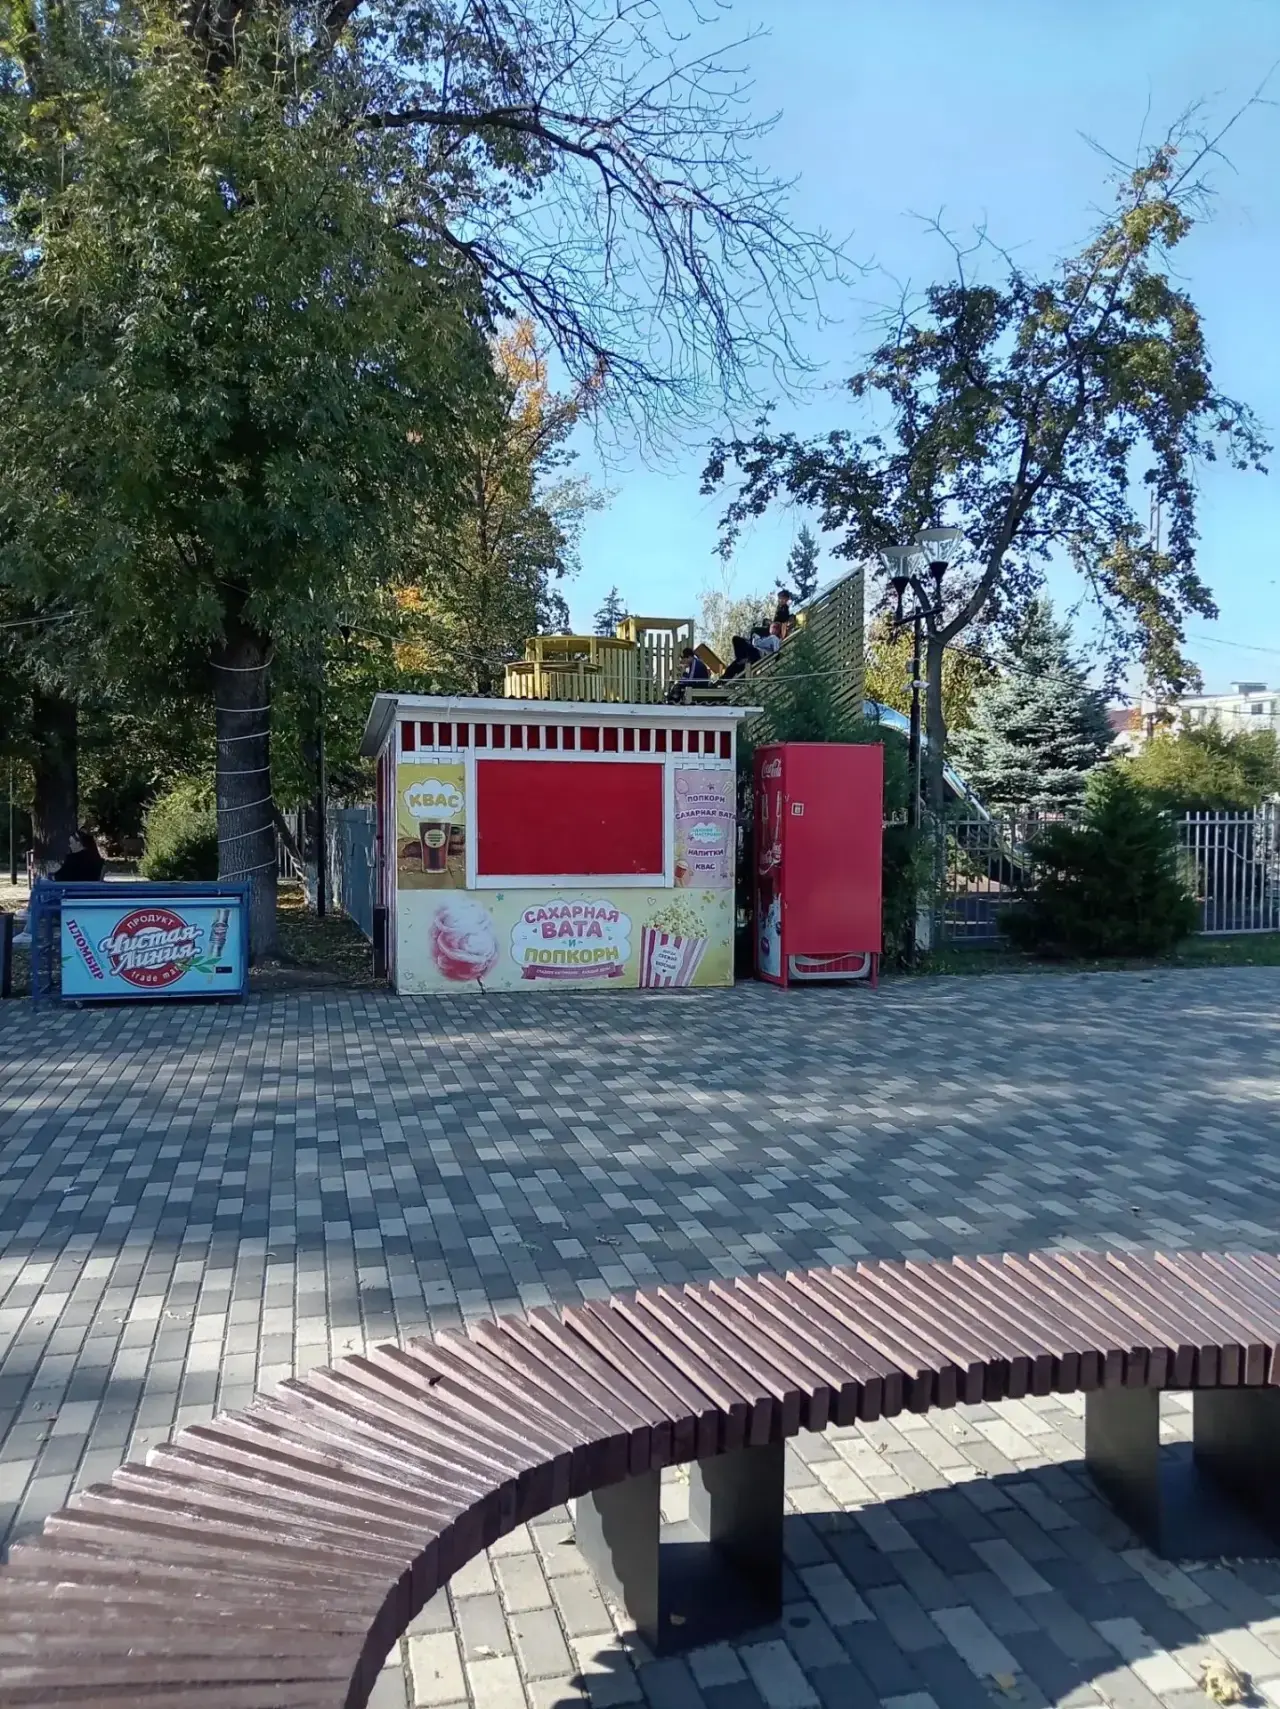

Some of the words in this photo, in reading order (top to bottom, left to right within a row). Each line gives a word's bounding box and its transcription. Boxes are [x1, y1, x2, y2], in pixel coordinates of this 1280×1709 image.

[409, 793, 460, 808] КВАС
[687, 795, 726, 803] ПОПКОРН
[675, 809, 717, 820] САХАРНАЯ
[718, 810, 737, 820] ВАТА
[688, 849, 724, 858] НАПИТКИ
[126, 914, 175, 930] ПРОДУКТ
[524, 906, 620, 923] САХАРНАЯ
[541, 920, 603, 939] ВАТА
[99, 924, 204, 955] Чистая
[66, 919, 105, 980] ПЛОМБИР
[524, 946, 619, 964] ПОПКОРН
[110, 946, 203, 976] Линия
[131, 971, 158, 982] trade
[162, 966, 181, 979] mar
